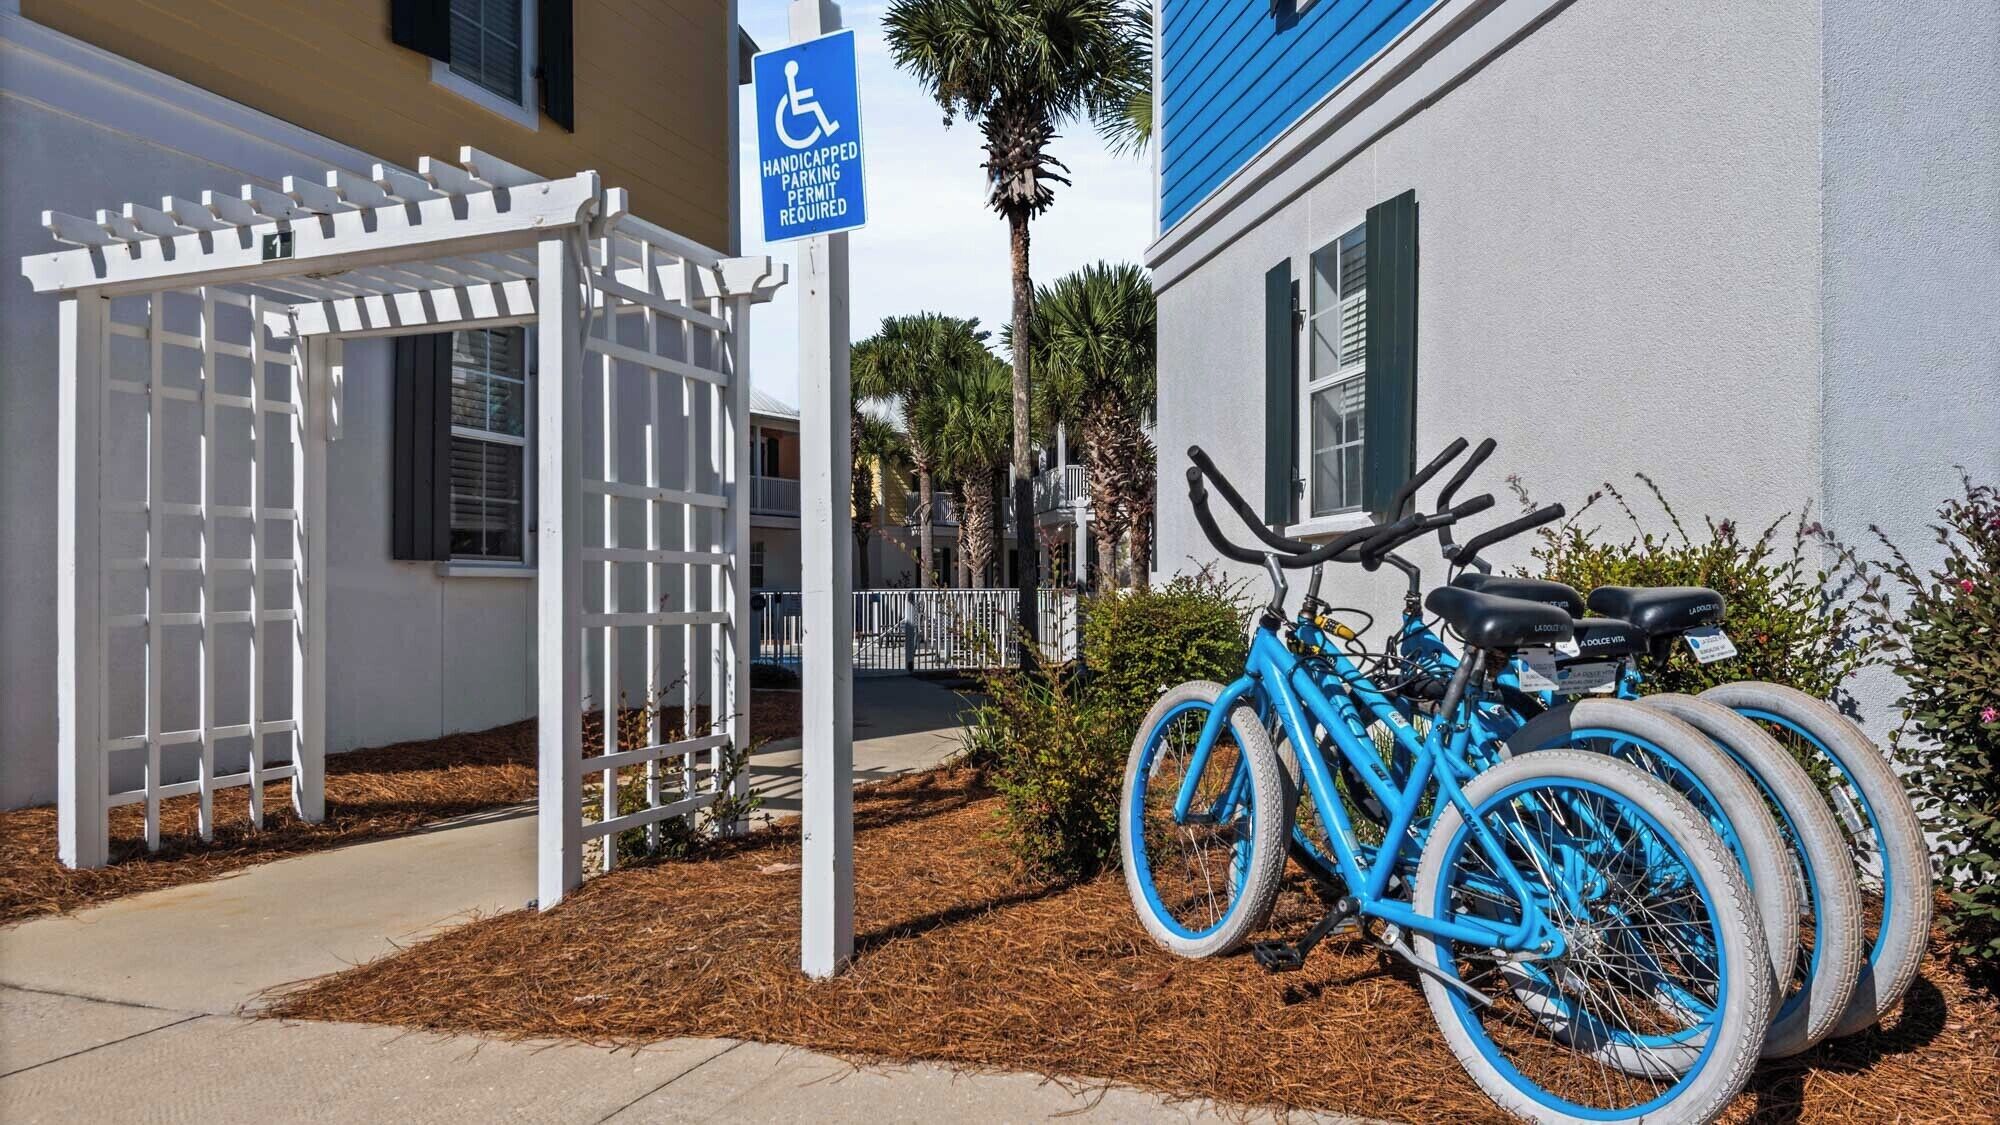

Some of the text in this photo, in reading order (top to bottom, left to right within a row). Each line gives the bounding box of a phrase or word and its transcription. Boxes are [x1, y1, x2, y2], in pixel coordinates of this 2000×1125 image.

[763, 141, 858, 178] HANDICAPPED
[781, 163, 841, 191] PARKING
[788, 182, 837, 207] PERMIT
[780, 198, 847, 226] REQUIRED
[272, 235, 281, 257] 1
[1697, 604, 1712, 613] DOLCE
[1534, 624, 1543, 632] LA
[1587, 637, 1611, 647] DOLCE
[1611, 635, 1626, 644] VITA
